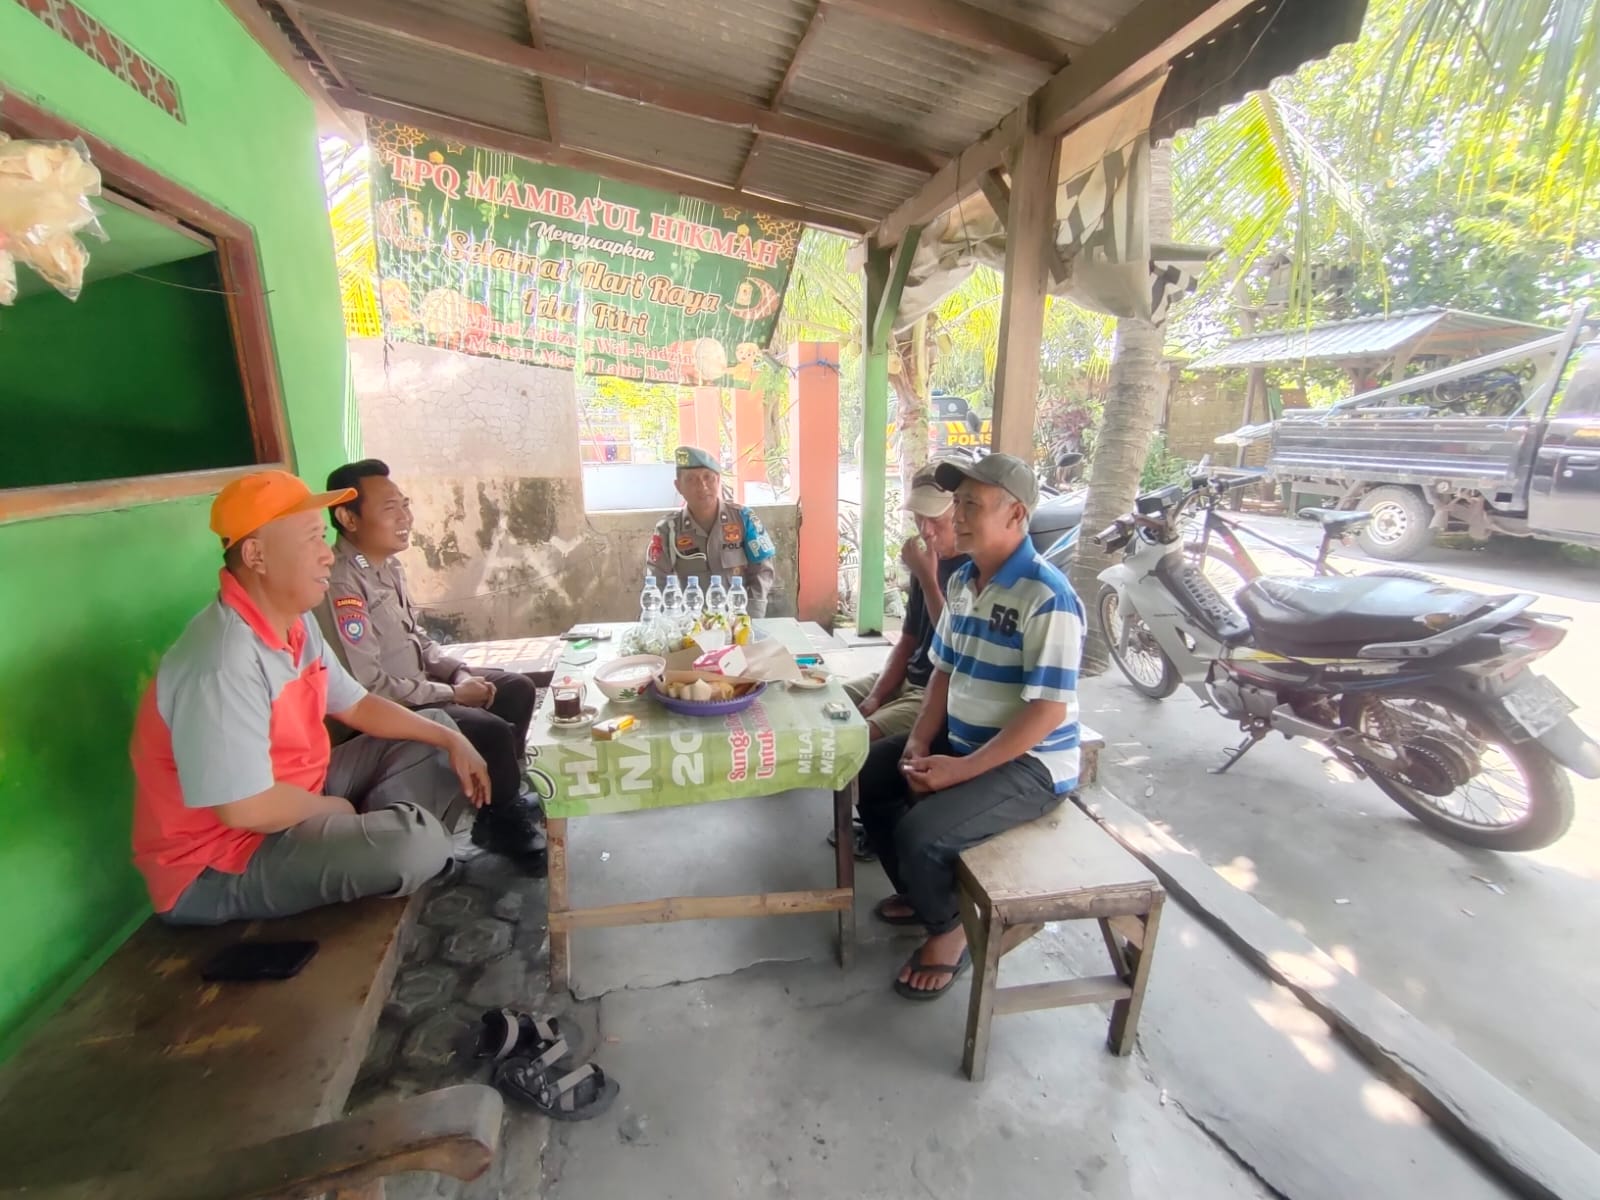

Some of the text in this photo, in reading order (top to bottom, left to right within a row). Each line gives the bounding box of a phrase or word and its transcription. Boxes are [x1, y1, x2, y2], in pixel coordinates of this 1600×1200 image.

[387, 150, 782, 268] TPQ MAMBA'UL HIKMAH
[529, 220, 656, 262] Mengucapkan
[444, 230, 722, 316] Selamat Hari Raya
[591, 300, 651, 336] Fitri
[988, 603, 1020, 637] 56
